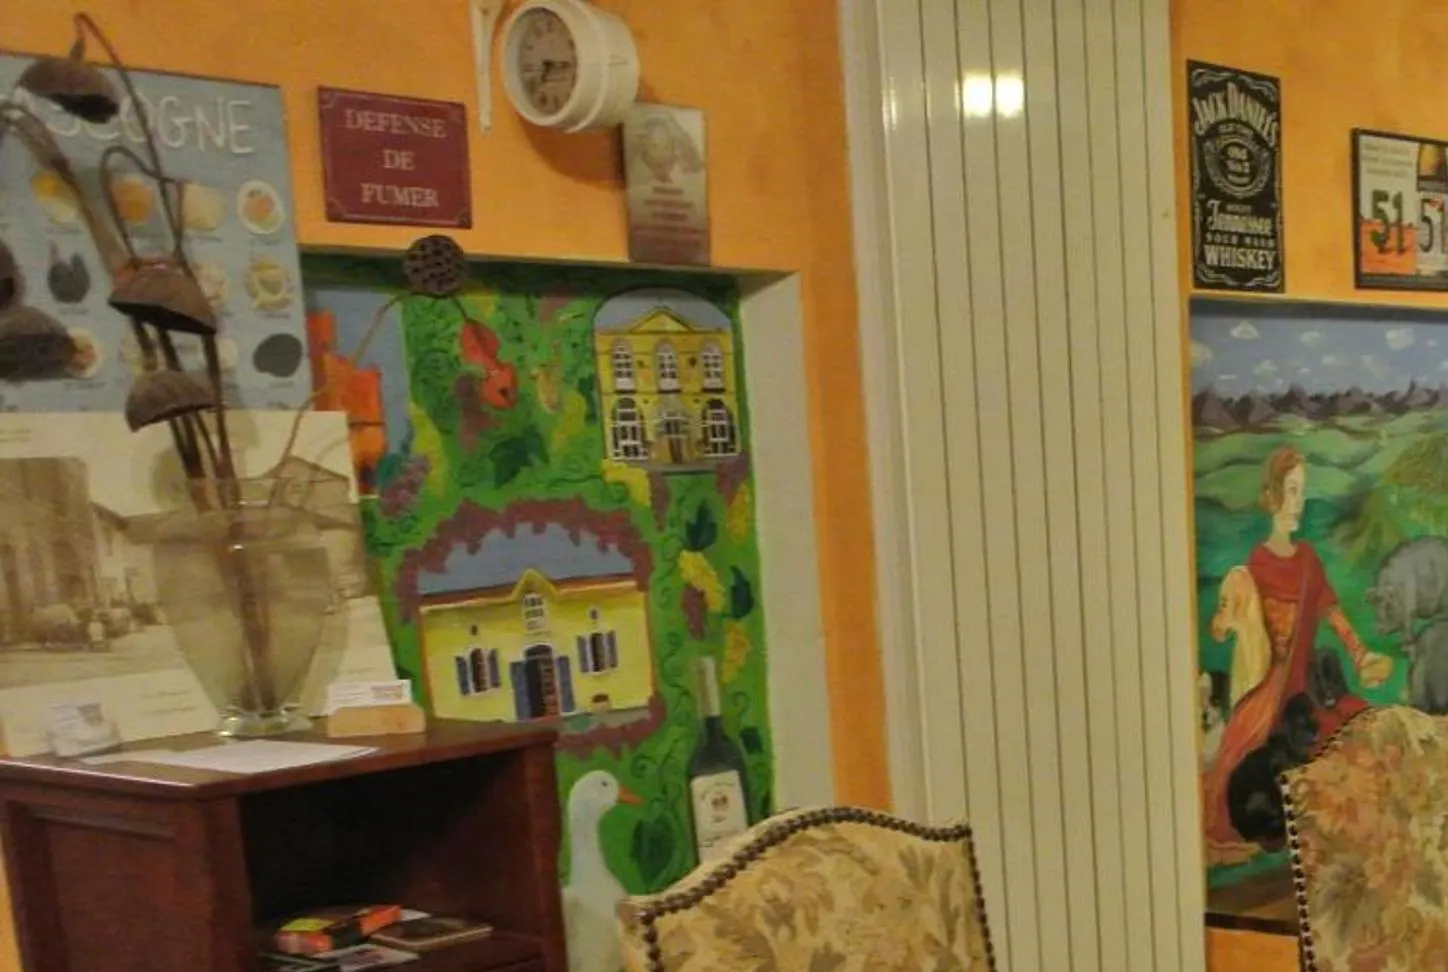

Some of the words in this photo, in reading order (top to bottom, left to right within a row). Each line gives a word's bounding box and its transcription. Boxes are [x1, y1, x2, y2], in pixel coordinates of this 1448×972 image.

[344, 108, 448, 139] DEFENSE
[382, 148, 416, 172] DE
[360, 182, 440, 209] FUMER
[1370, 188, 1405, 257] 51
[1203, 244, 1277, 270] WHISKEY
